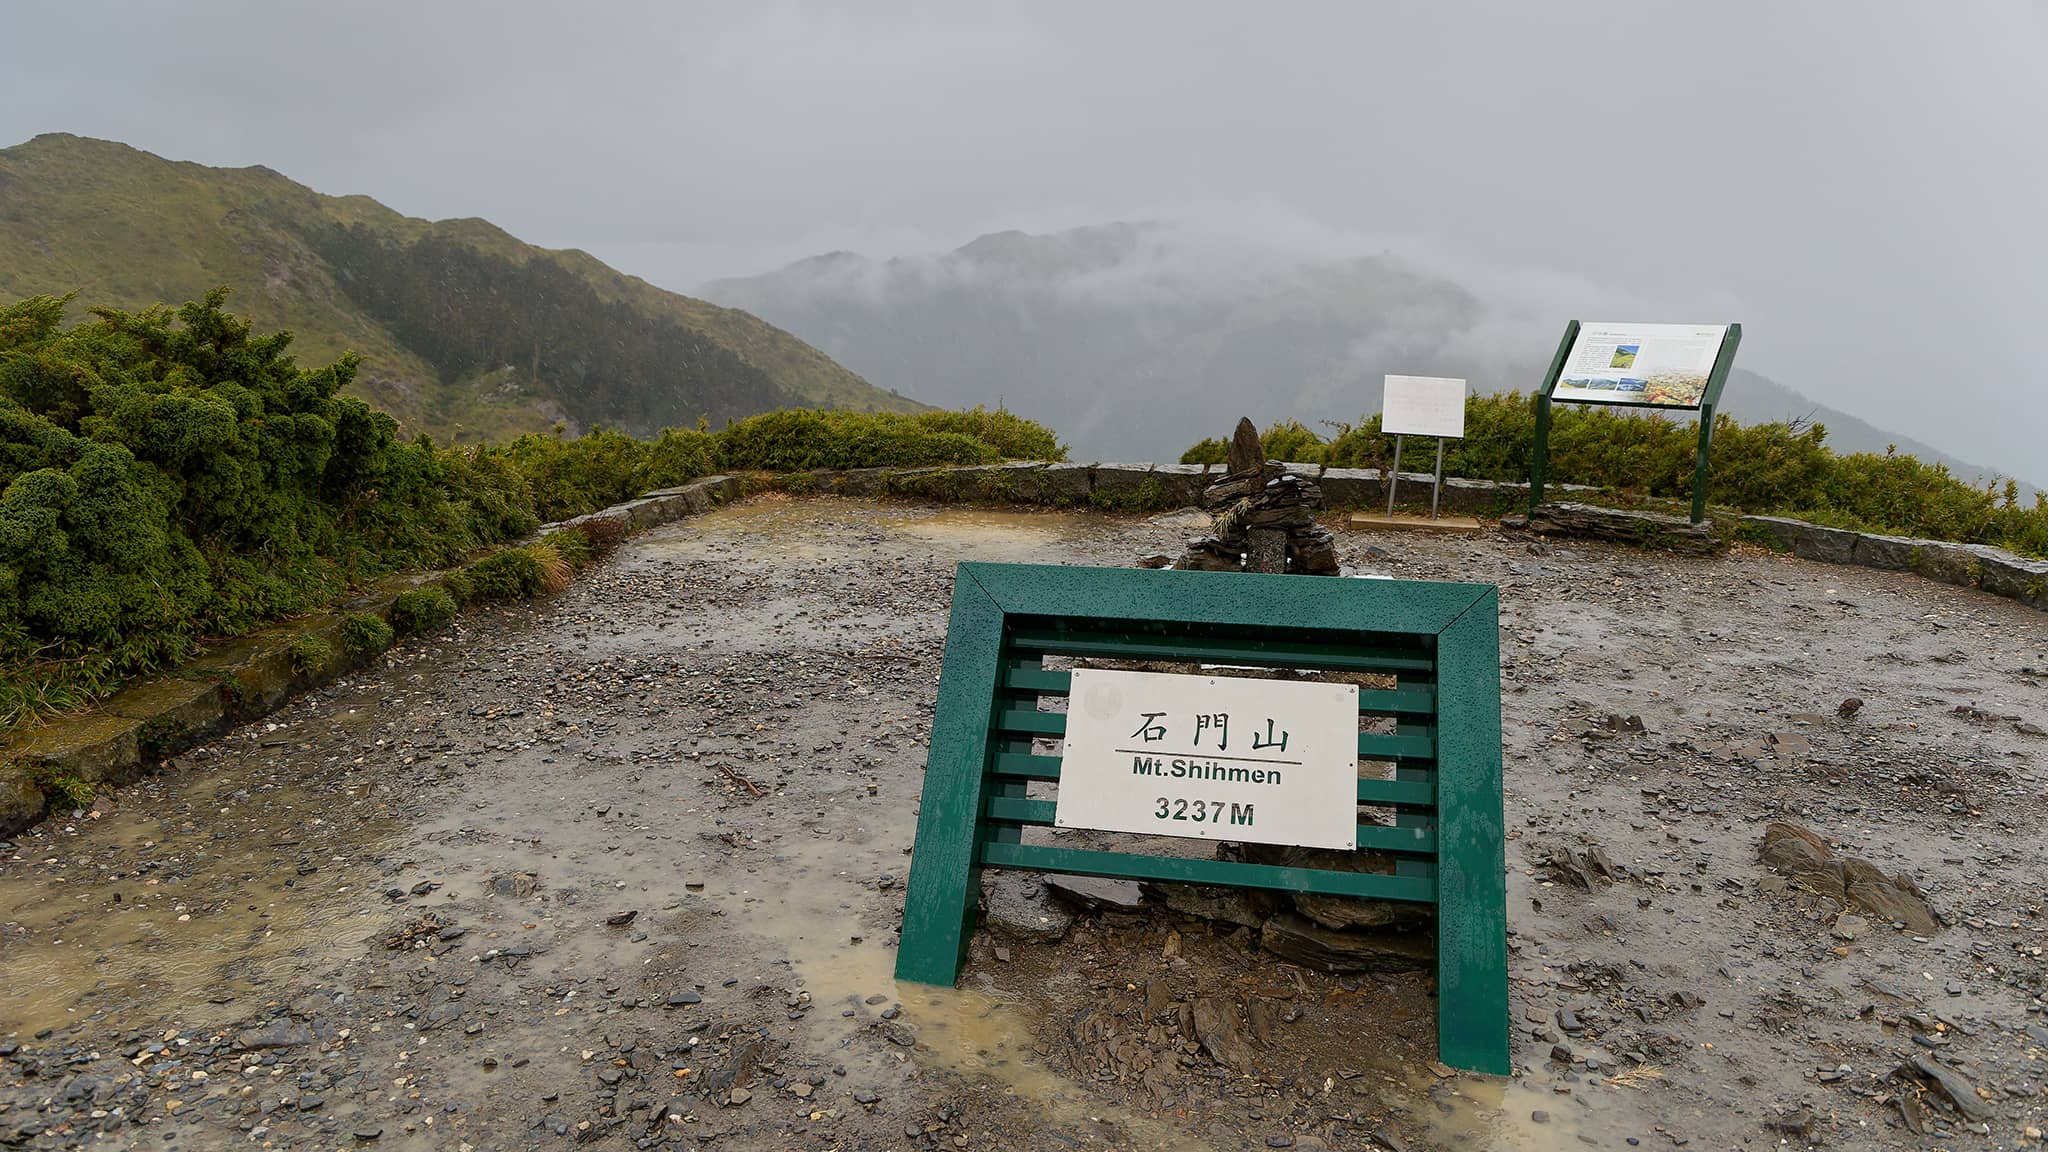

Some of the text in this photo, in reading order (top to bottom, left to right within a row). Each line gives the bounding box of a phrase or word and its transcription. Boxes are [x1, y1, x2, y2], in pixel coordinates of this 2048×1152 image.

[1131, 712, 1289, 752] 石門山
[1132, 756, 1281, 784] Mt.Shihmen
[1154, 797, 1254, 825] 3237M
